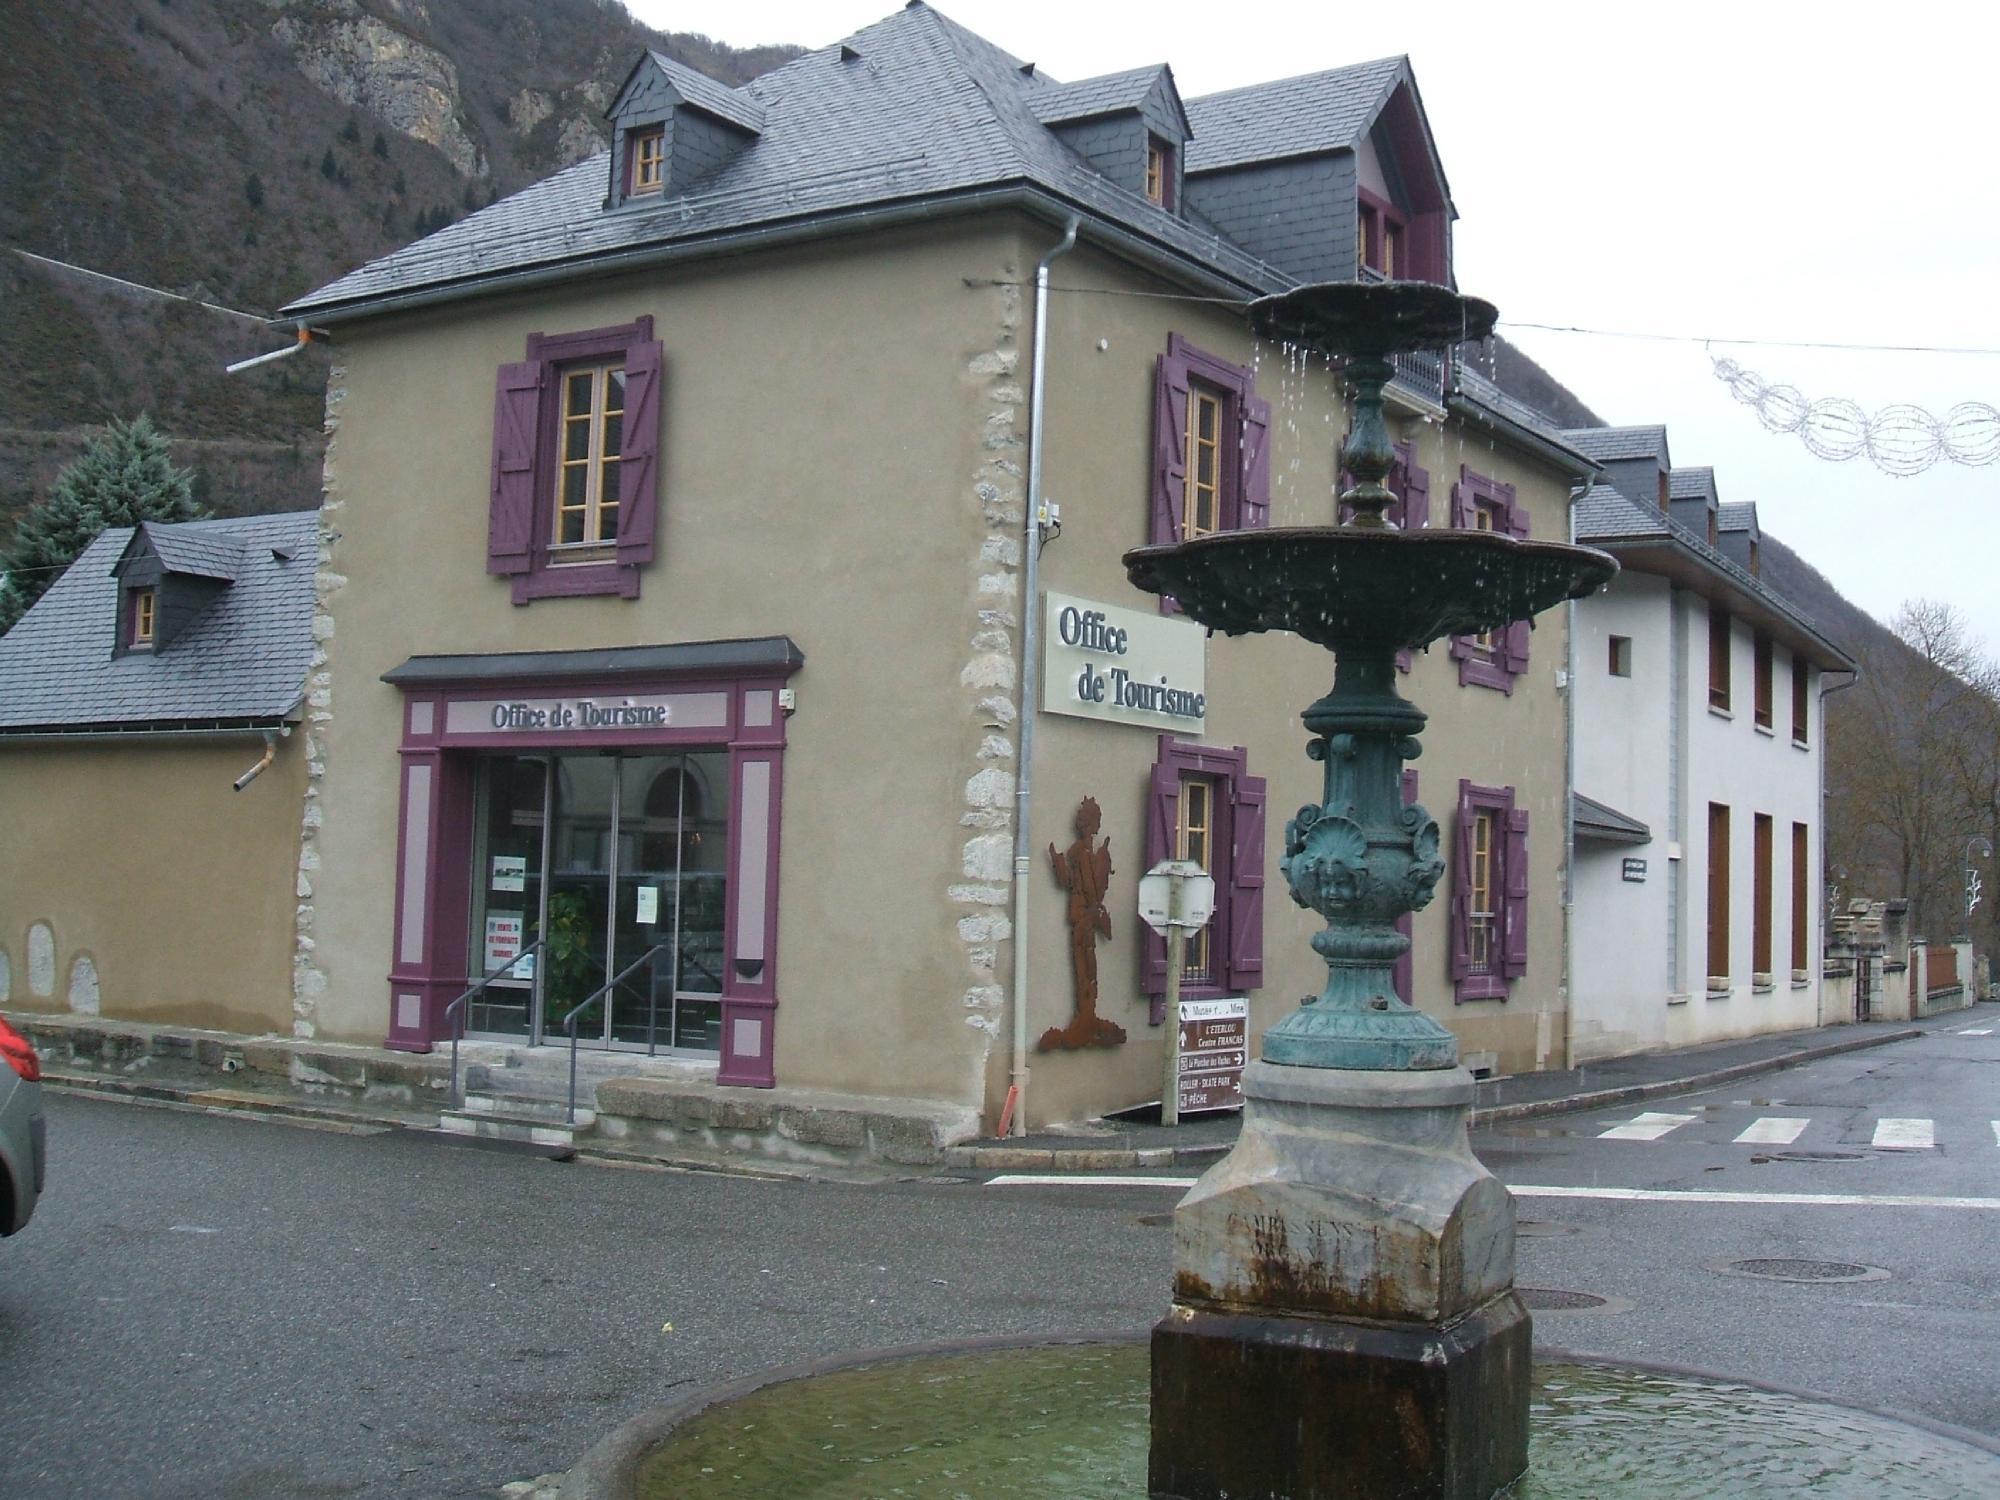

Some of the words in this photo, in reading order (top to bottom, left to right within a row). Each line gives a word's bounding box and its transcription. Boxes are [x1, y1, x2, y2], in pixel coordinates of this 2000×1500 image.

[1059, 606, 1128, 655] Office
[1078, 663, 1105, 703] de
[1111, 668, 1206, 719] Tourisme
[491, 703, 546, 729] Office
[549, 702, 573, 728] de
[577, 700, 666, 727] Tourisme
[1198, 1038, 1217, 1048] Centre
[1217, 1035, 1244, 1046] FRANCAS
[1180, 1079, 1199, 1090] ROLLER
[1202, 1077, 1217, 1088] SKATE
[1217, 1076, 1232, 1087] PARK
